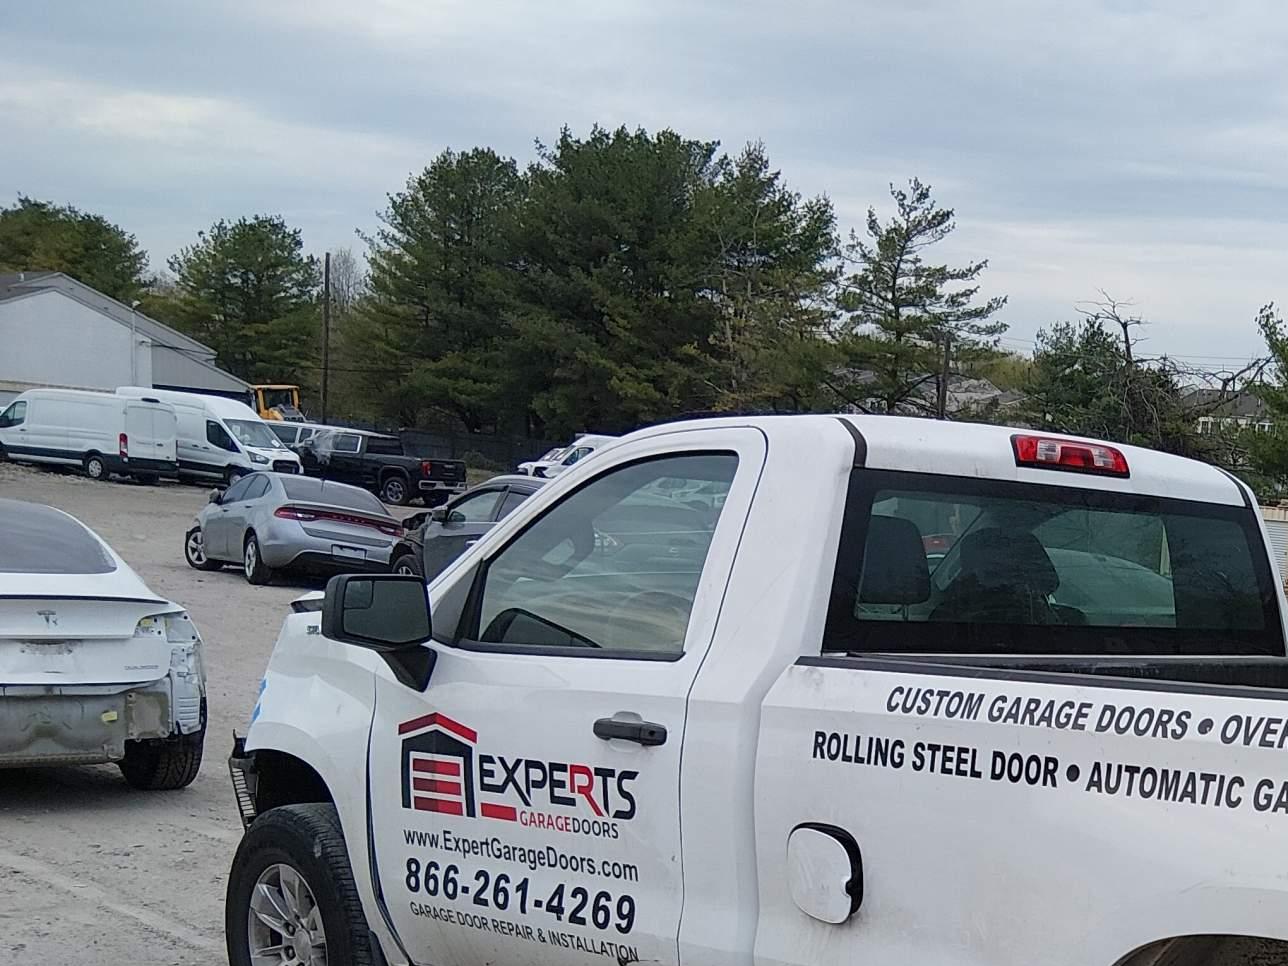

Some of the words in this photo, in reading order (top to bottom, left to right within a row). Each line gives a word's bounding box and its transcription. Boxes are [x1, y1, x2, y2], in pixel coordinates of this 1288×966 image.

[885, 686, 985, 721] CUSTOM
[987, 695, 1093, 732] GARAGE
[1095, 704, 1192, 740] DOORS
[478, 754, 639, 820] EXPERTS
[812, 730, 906, 769] ROLLING
[911, 741, 982, 779] STEEL
[990, 751, 1059, 788] DOOR
[1085, 762, 1243, 810] AUTOMATIC
[403, 829, 639, 882] www.ExpertGarageDoors.com
[405, 857, 636, 935] 866-261-4269
[410, 901, 454, 924] GARAGE
[457, 911, 490, 932] DOOR
[493, 918, 536, 942] REPAIR
[537, 928, 546, 942] &
[548, 930, 639, 962] INSTALLATION
